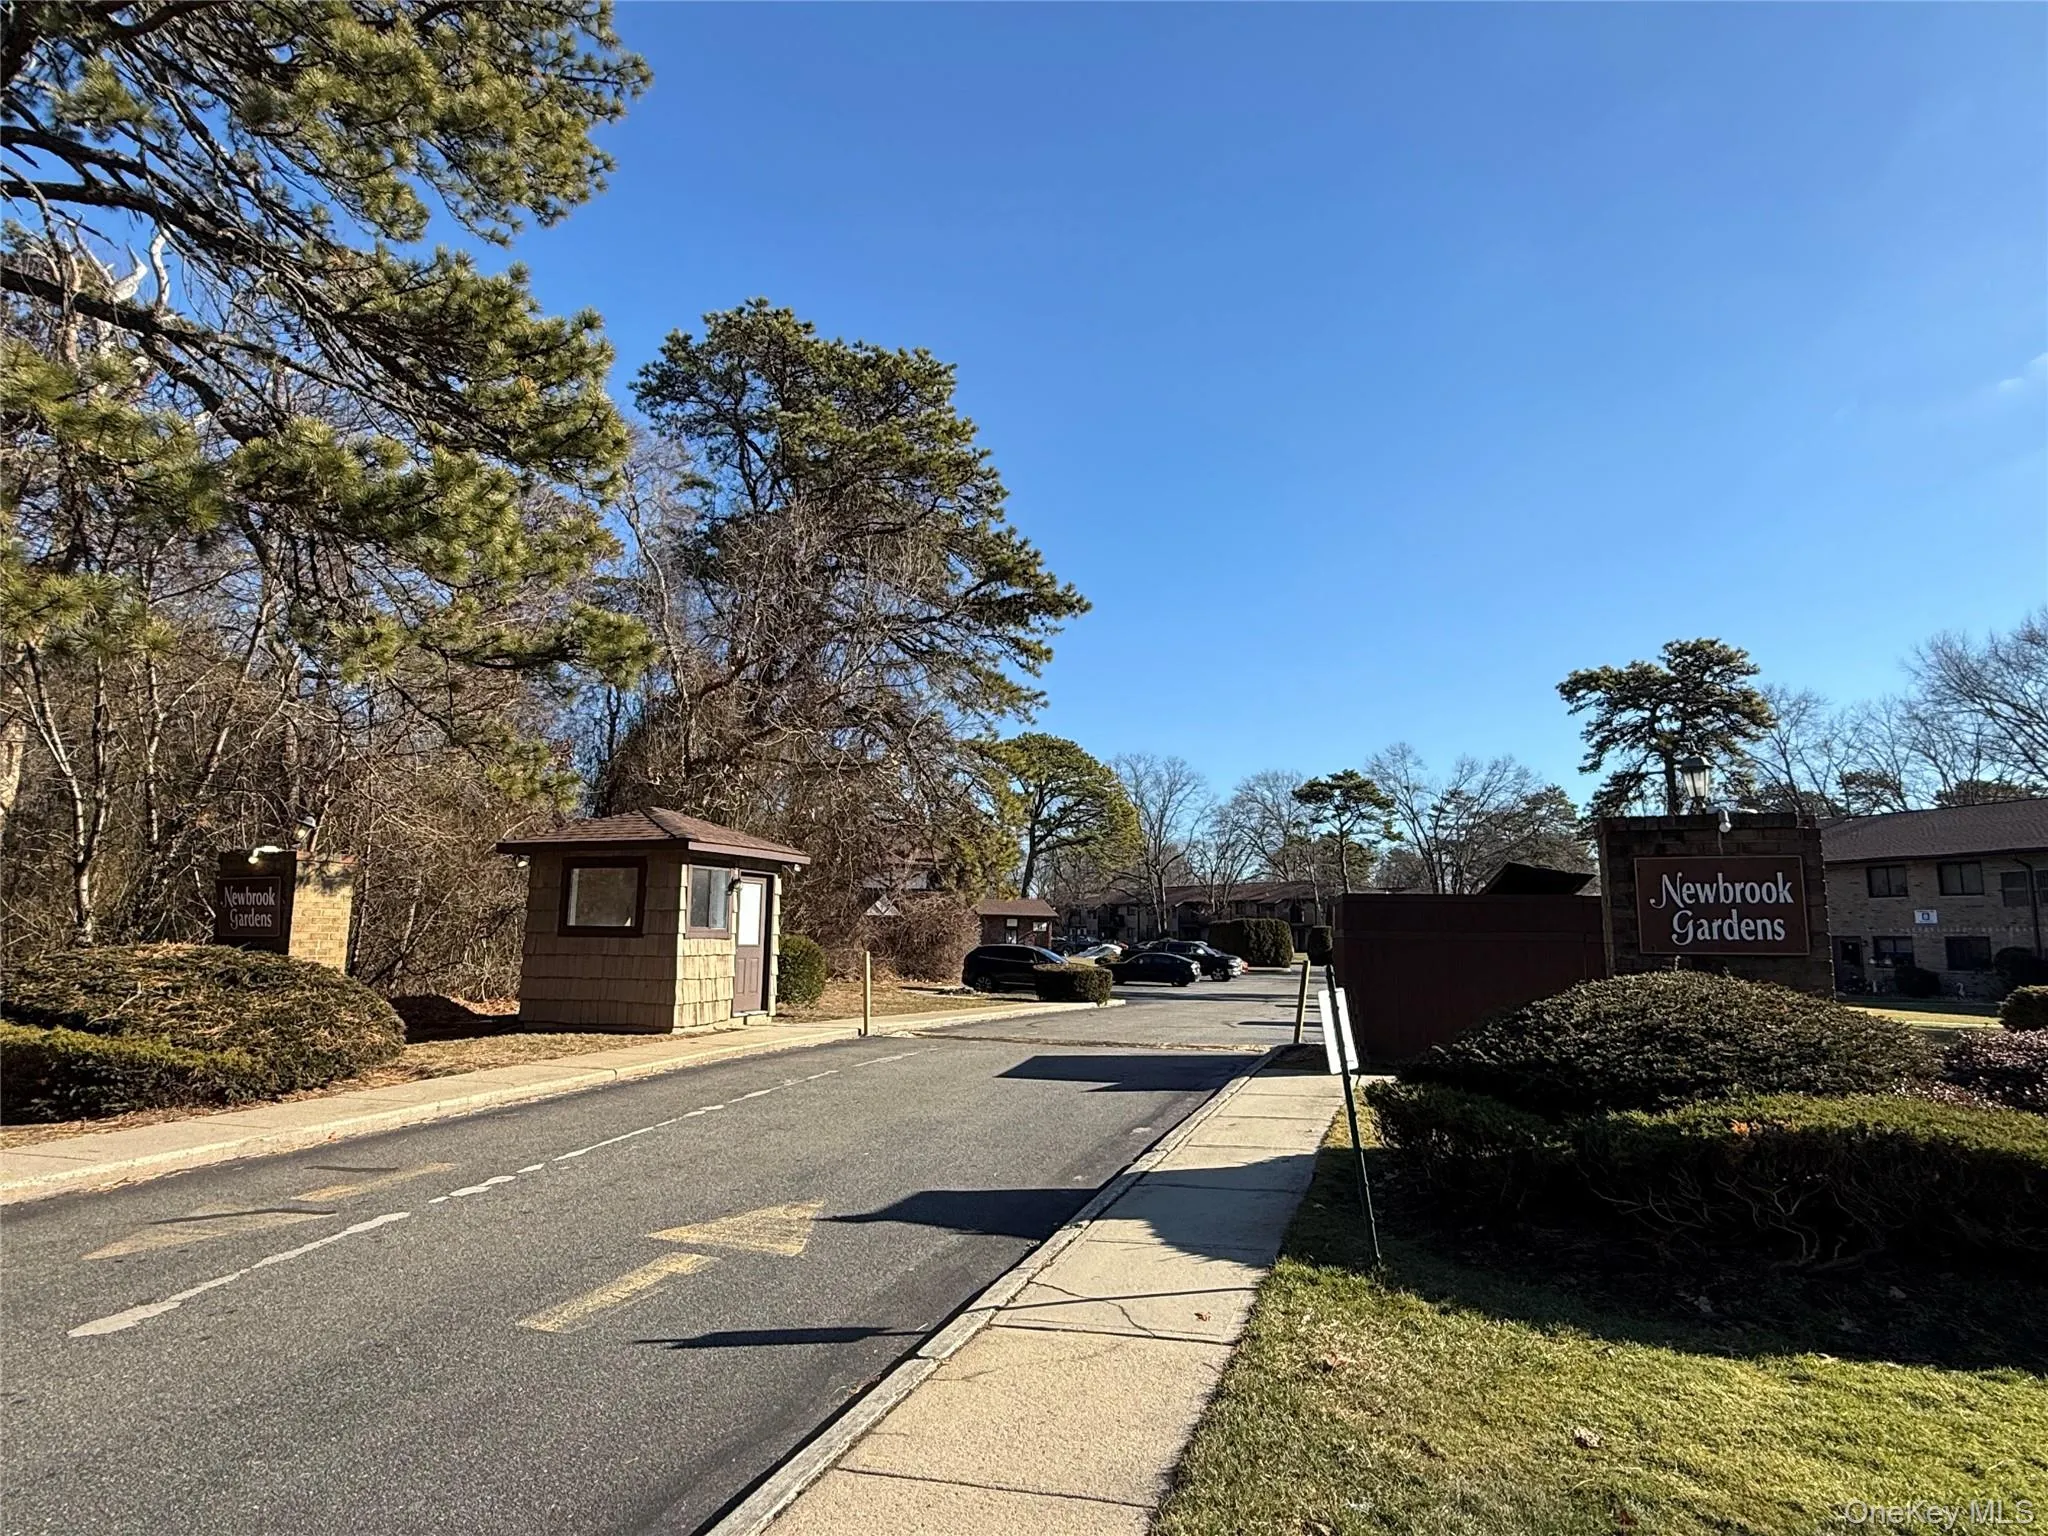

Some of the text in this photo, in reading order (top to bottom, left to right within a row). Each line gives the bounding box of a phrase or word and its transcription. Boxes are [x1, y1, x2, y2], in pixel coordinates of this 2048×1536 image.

[220, 885, 276, 907] Newbrook
[1650, 872, 1794, 908] Newbrook
[230, 908, 272, 929] Gardens
[1671, 909, 1786, 946] Gardens
